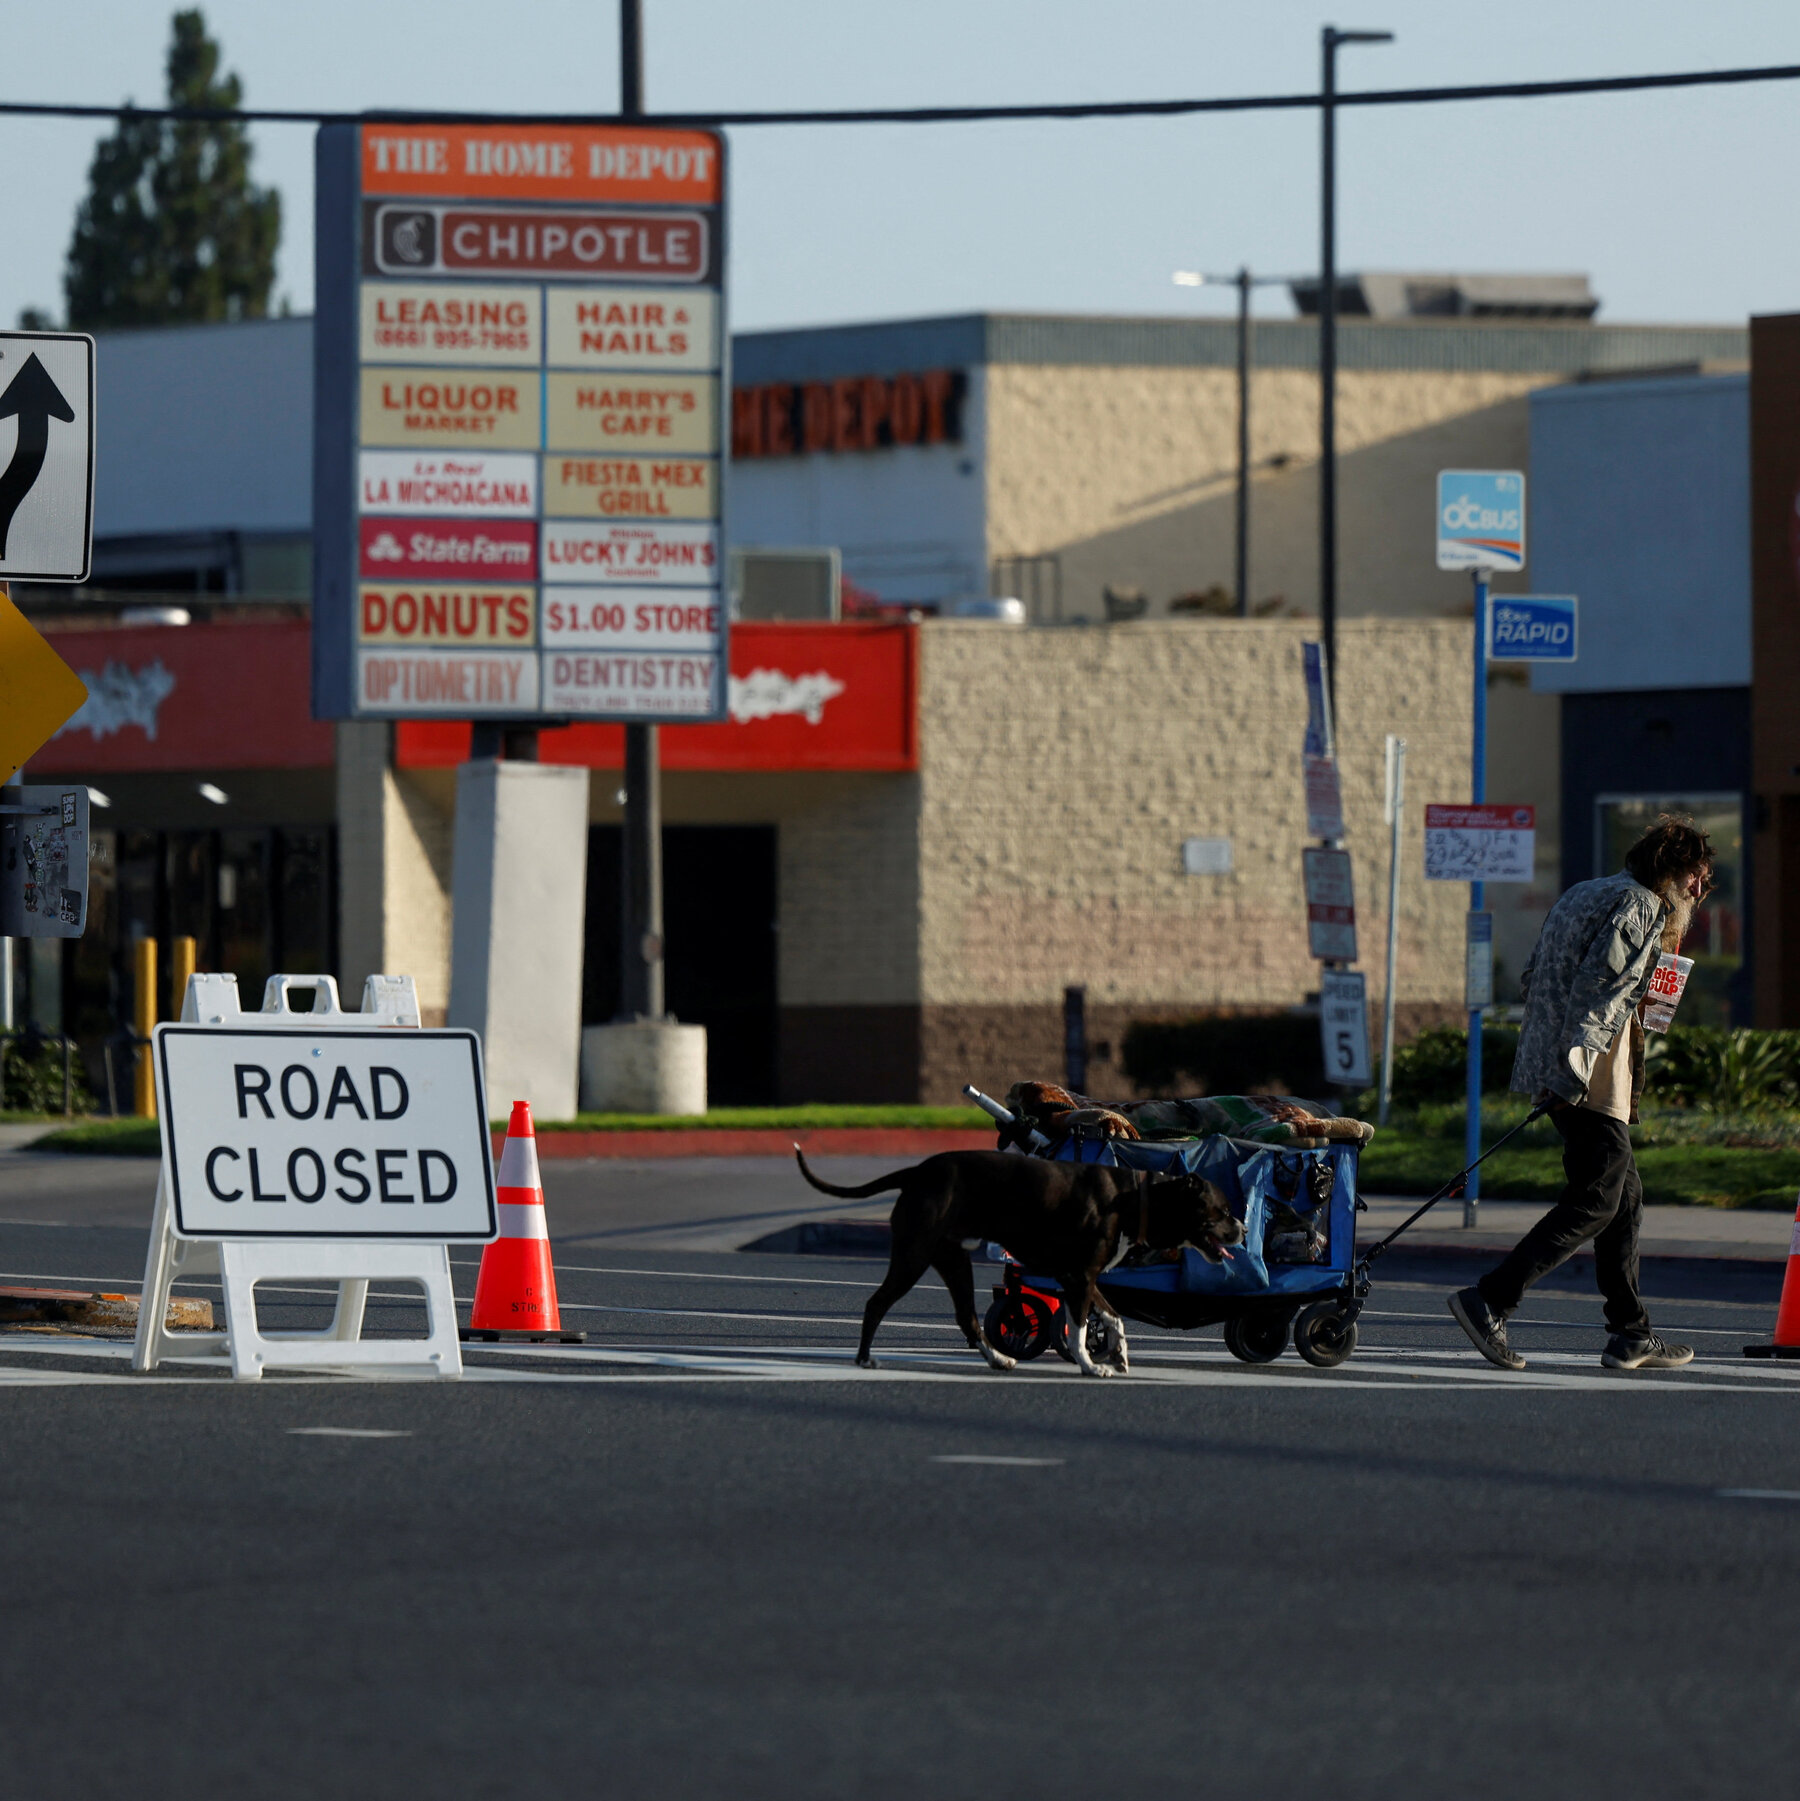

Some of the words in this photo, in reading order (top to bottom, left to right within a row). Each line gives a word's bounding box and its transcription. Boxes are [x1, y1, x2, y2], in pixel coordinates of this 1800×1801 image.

[369, 137, 447, 173] THE
[465, 140, 573, 177] HOME
[589, 143, 715, 182] DEPOT
[452, 223, 691, 265] CHIPOTLE
[376, 299, 527, 327] LEASING
[577, 304, 664, 326] HAIR
[674, 310, 689, 324] &
[580, 332, 688, 355] NAILS
[382, 385, 518, 412] LIQUOR
[577, 388, 696, 412] HARRY'S
[802, 368, 952, 453] DEPOT
[404, 416, 496, 434] MARKET
[601, 415, 672, 437] CAFE
[562, 461, 641, 487] FIESTA
[651, 464, 706, 488] MEX
[364, 481, 391, 504] LA
[398, 481, 531, 507] MICHOACANA
[599, 490, 671, 515] GRILL
[548, 540, 629, 565] LUCKY
[636, 541, 717, 566] JOHN'S
[361, 594, 530, 637] DONUTS
[546, 603, 625, 633] $1.00
[635, 606, 720, 633] STORE
[1495, 622, 1569, 644] RAPID
[365, 658, 523, 704] OPTOMETRY
[553, 656, 715, 689] DENTISTRY
[1336, 1031, 1355, 1071] 5
[233, 1064, 410, 1121] ROAD
[205, 1146, 458, 1204] CLOSED
